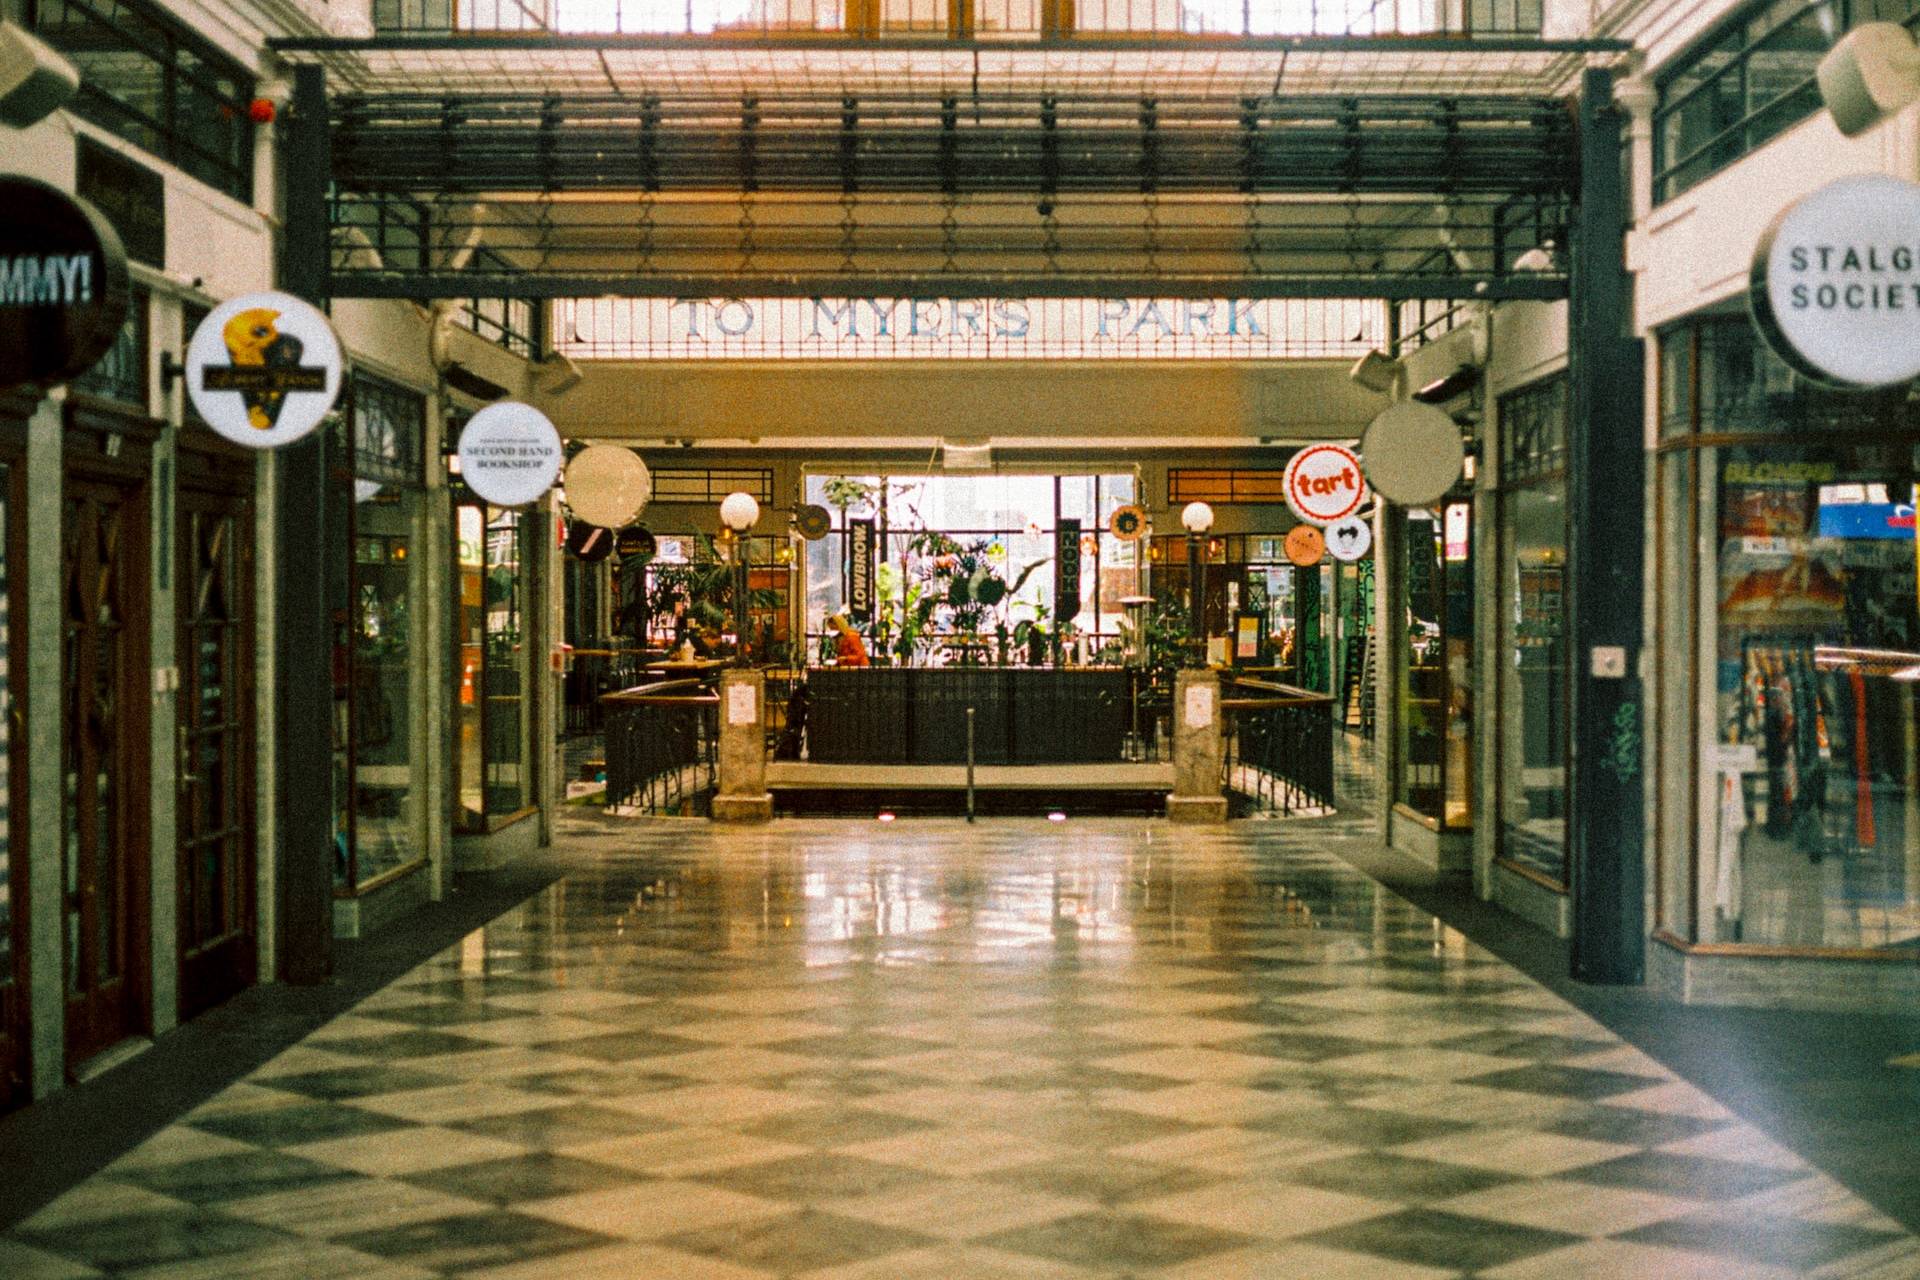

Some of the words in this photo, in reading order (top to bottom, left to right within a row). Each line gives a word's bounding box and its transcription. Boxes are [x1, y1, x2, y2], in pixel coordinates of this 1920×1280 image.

[1791, 246, 1920, 271] STALG
[674, 299, 753, 337] TO
[809, 299, 1029, 337] MYERS
[1094, 299, 1265, 337] PARK
[519, 447, 553, 456] HAND
[1298, 468, 1354, 496] tart
